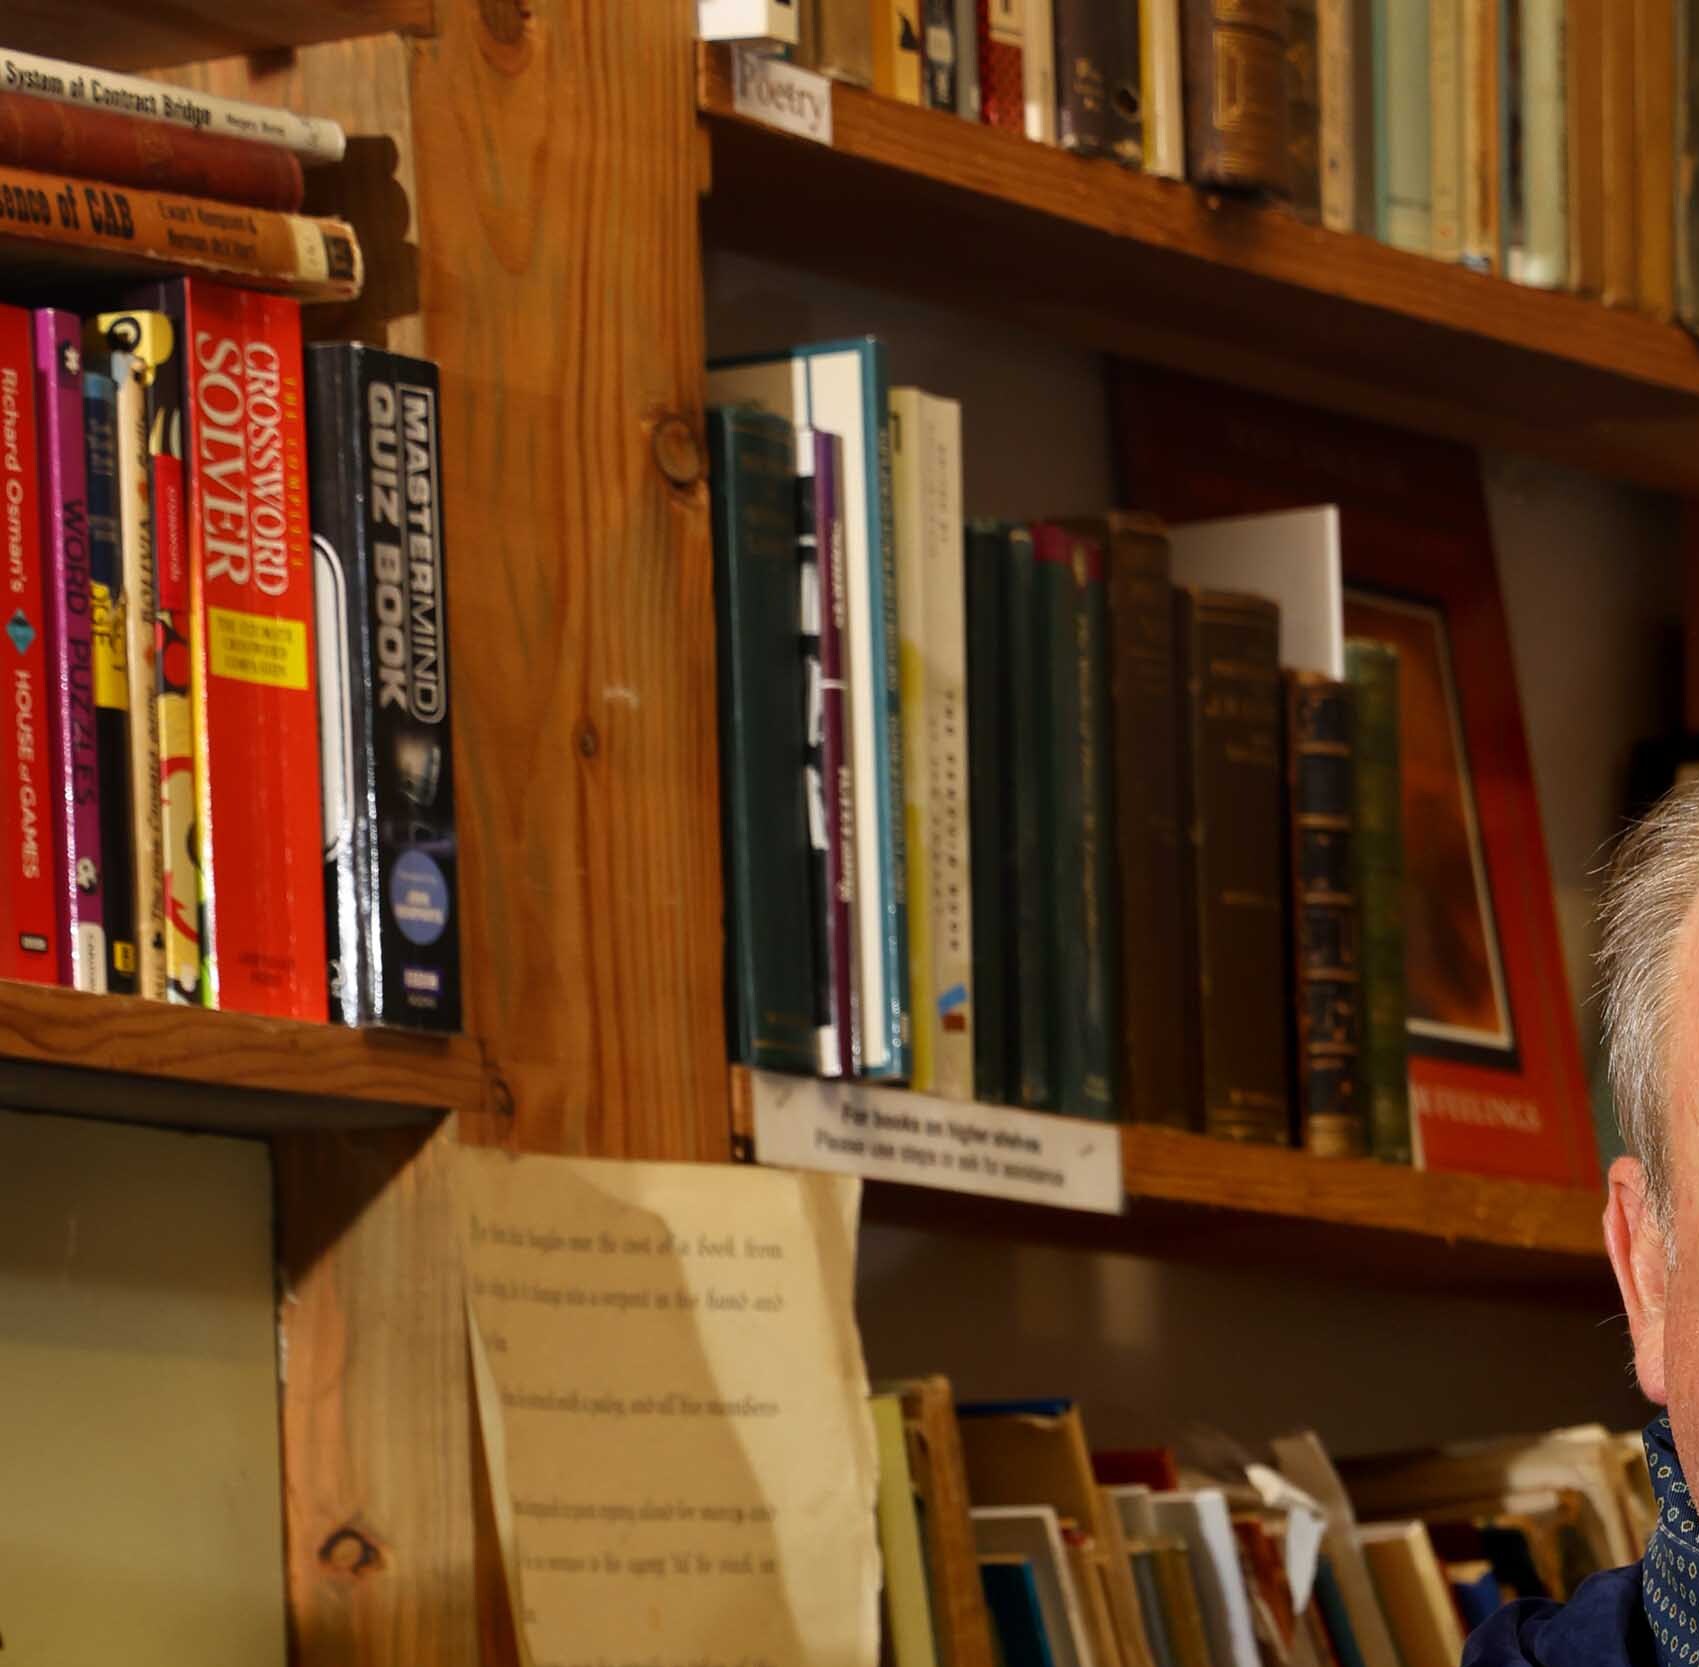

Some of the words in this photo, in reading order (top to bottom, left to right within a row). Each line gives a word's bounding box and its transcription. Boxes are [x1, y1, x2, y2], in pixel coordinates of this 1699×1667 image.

[5, 60, 64, 97] System
[90, 78, 157, 117] Contract
[162, 93, 212, 129] Bridge
[738, 48, 820, 134] Poetry
[57, 184, 80, 230] of
[84, 187, 134, 240] CAB
[2, 366, 22, 473] Richard
[195, 331, 250, 584] SOLVER
[243, 341, 289, 597] CROSSWORD
[368, 382, 400, 527] QUIZ
[6, 477, 26, 596] Osman's
[63, 499, 90, 616] WORD
[403, 396, 440, 714] MASTERMIND
[374, 541, 407, 712] BOOK
[14, 668, 35, 764] HOUSE
[69, 638, 96, 807] PUZZLES
[18, 784, 40, 880] GAMES
[873, 1107, 920, 1134] books
